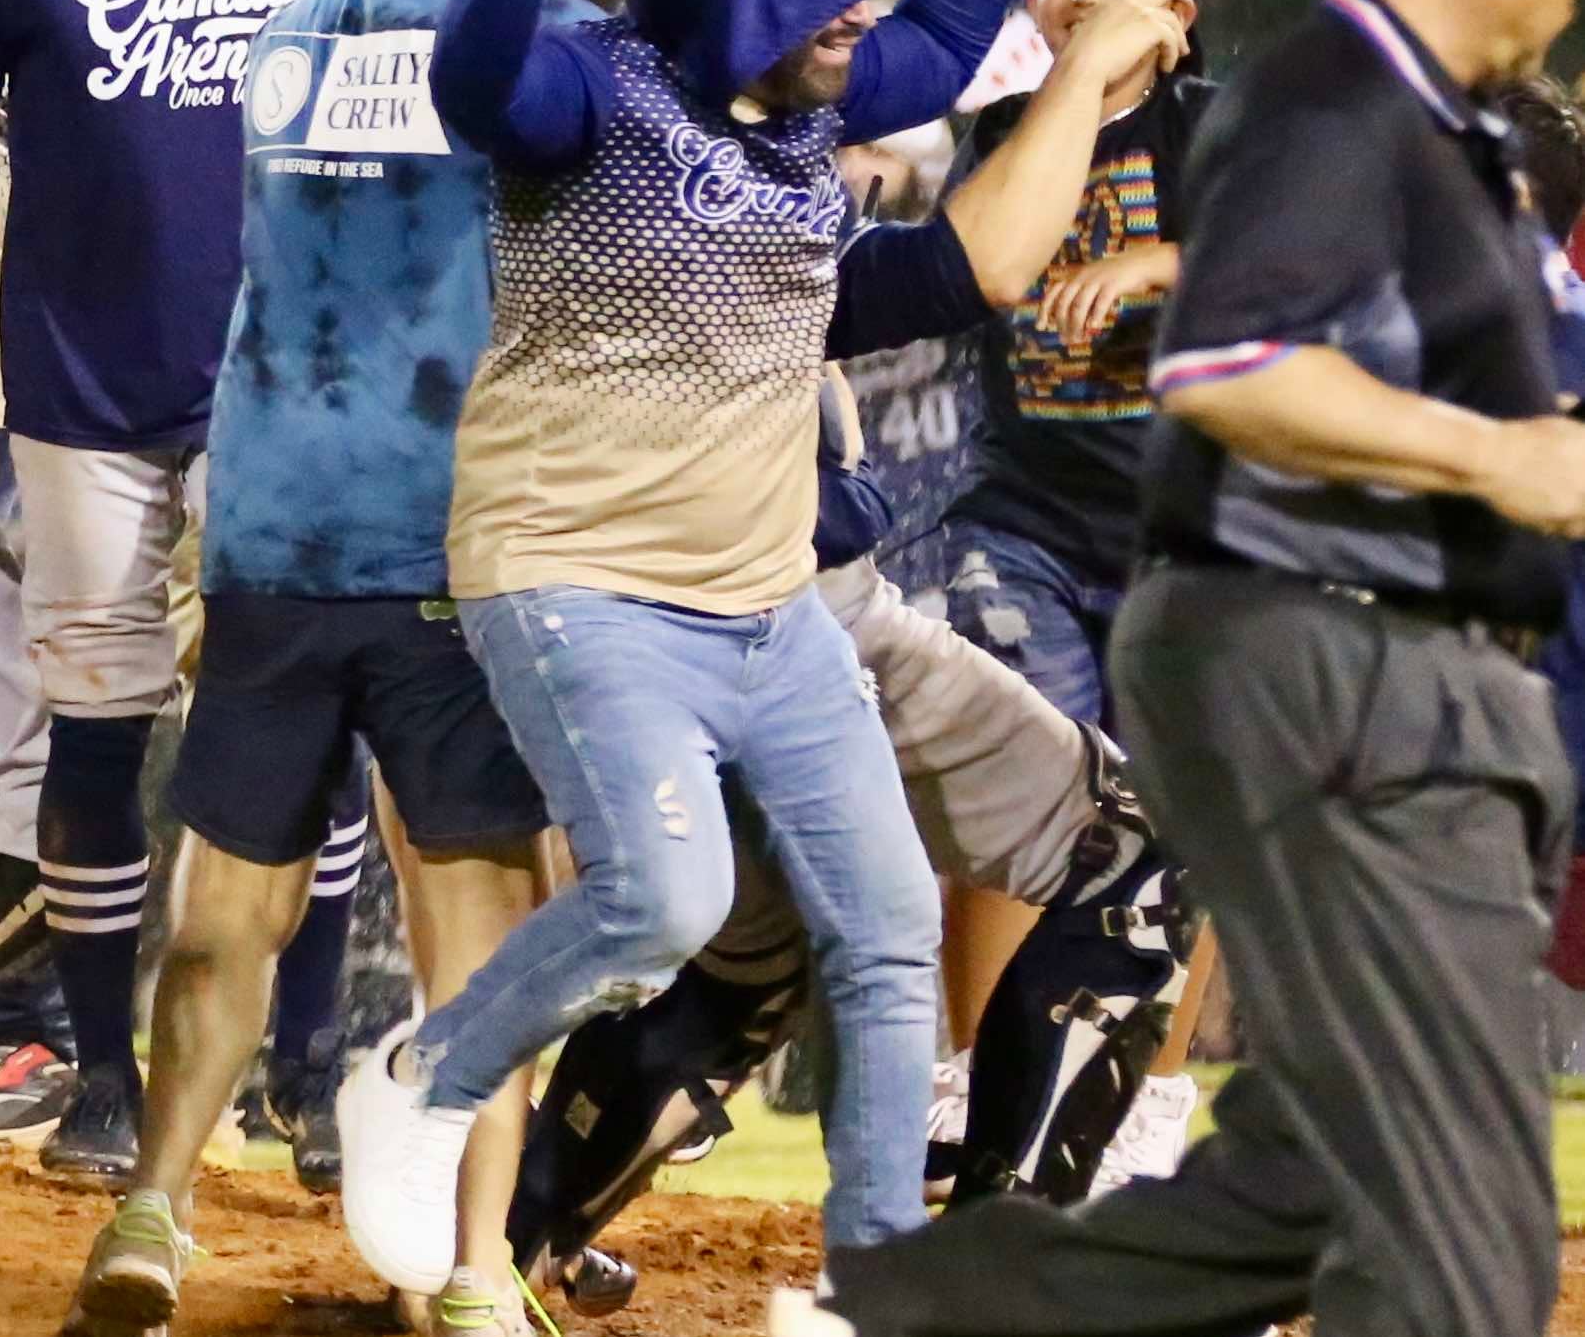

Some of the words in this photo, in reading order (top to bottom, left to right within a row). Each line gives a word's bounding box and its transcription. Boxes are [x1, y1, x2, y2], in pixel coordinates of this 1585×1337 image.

[86, 23, 250, 101] Aren
[337, 51, 433, 88] SALTY
[327, 96, 418, 130] CREW
[324, 160, 338, 177] IN
[339, 161, 359, 178] THE
[360, 161, 384, 178] SEA
